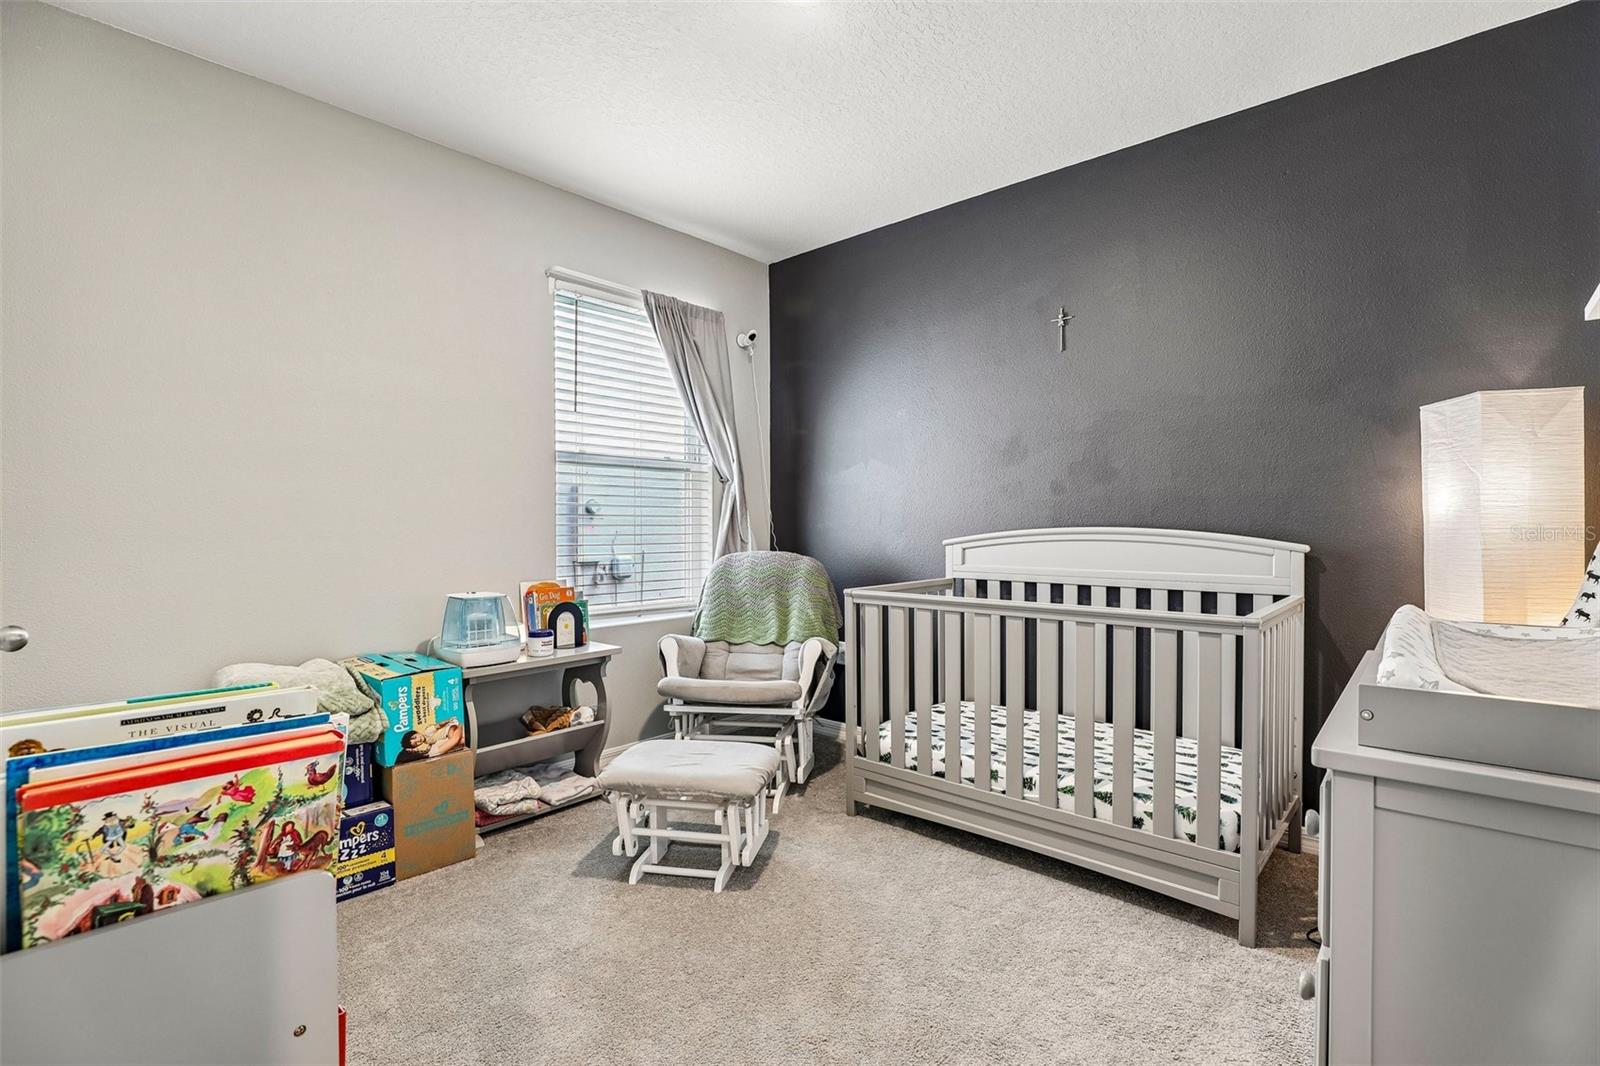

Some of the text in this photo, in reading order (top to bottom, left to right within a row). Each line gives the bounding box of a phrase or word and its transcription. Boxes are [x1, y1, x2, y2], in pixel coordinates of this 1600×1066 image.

[393, 686, 410, 733] Pampers
[414, 686, 423, 725] swaddlers
[128, 720, 217, 738] THE VISUAL
[339, 830, 380, 849] mpers
